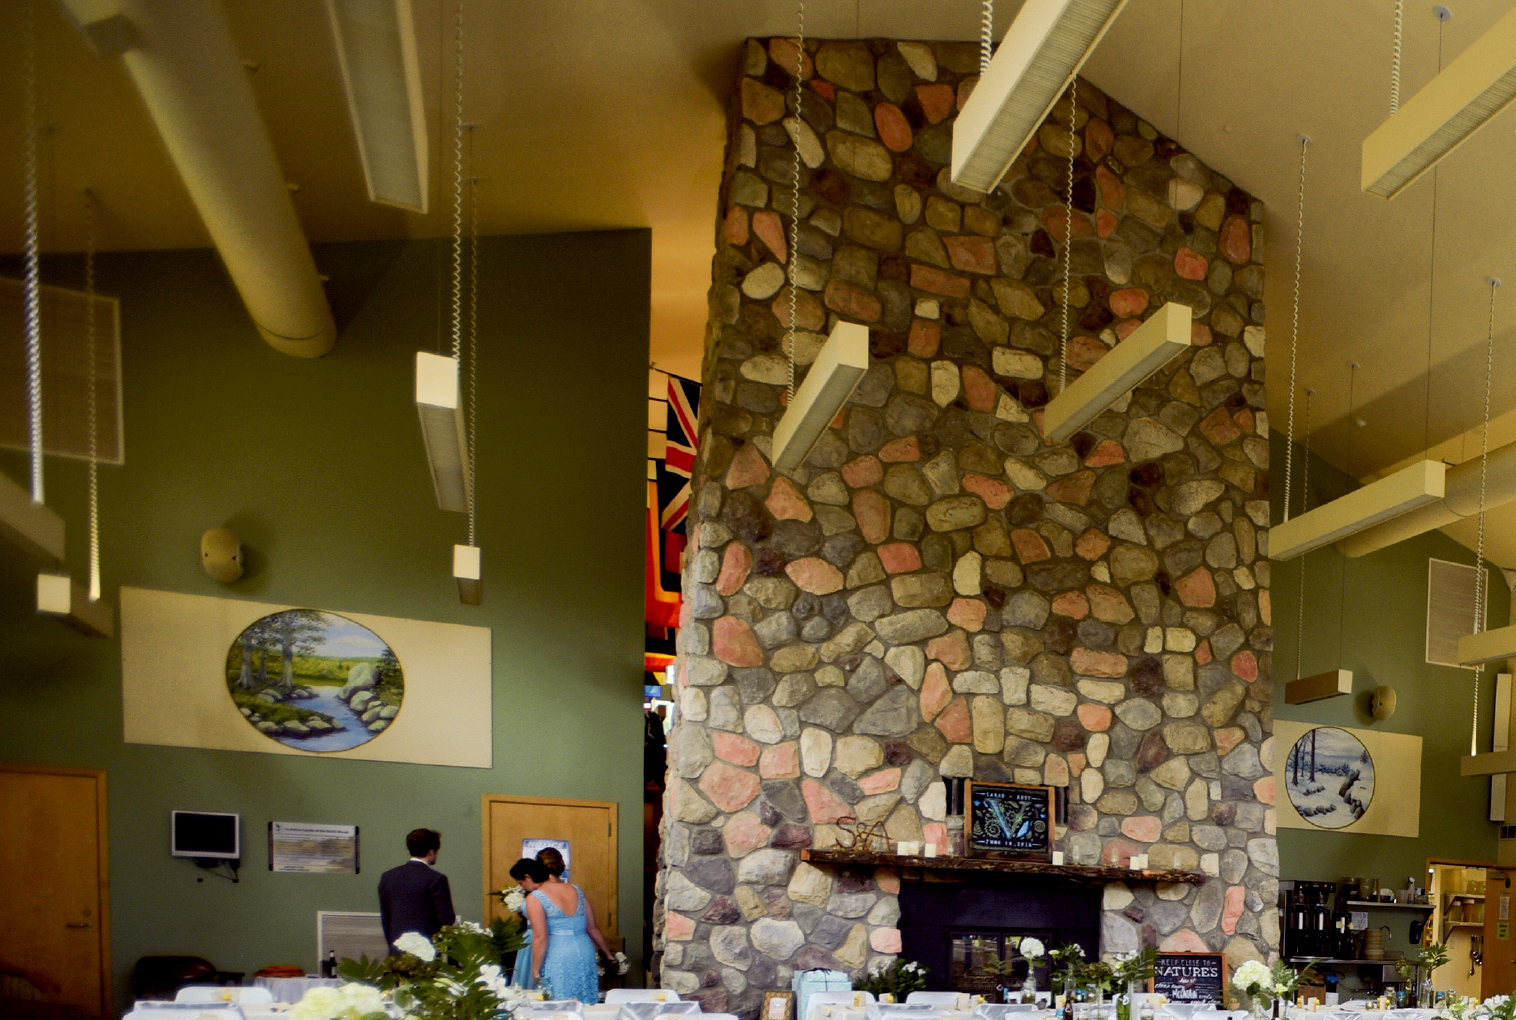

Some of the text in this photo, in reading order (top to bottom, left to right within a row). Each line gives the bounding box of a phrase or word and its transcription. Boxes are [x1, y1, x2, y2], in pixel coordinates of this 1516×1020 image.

[983, 797, 1032, 840] V
[527, 841, 564, 849] NOTICE
[1161, 958, 1211, 967] KEEP CLOSE TO
[1154, 966, 1218, 978] NATURE'S
